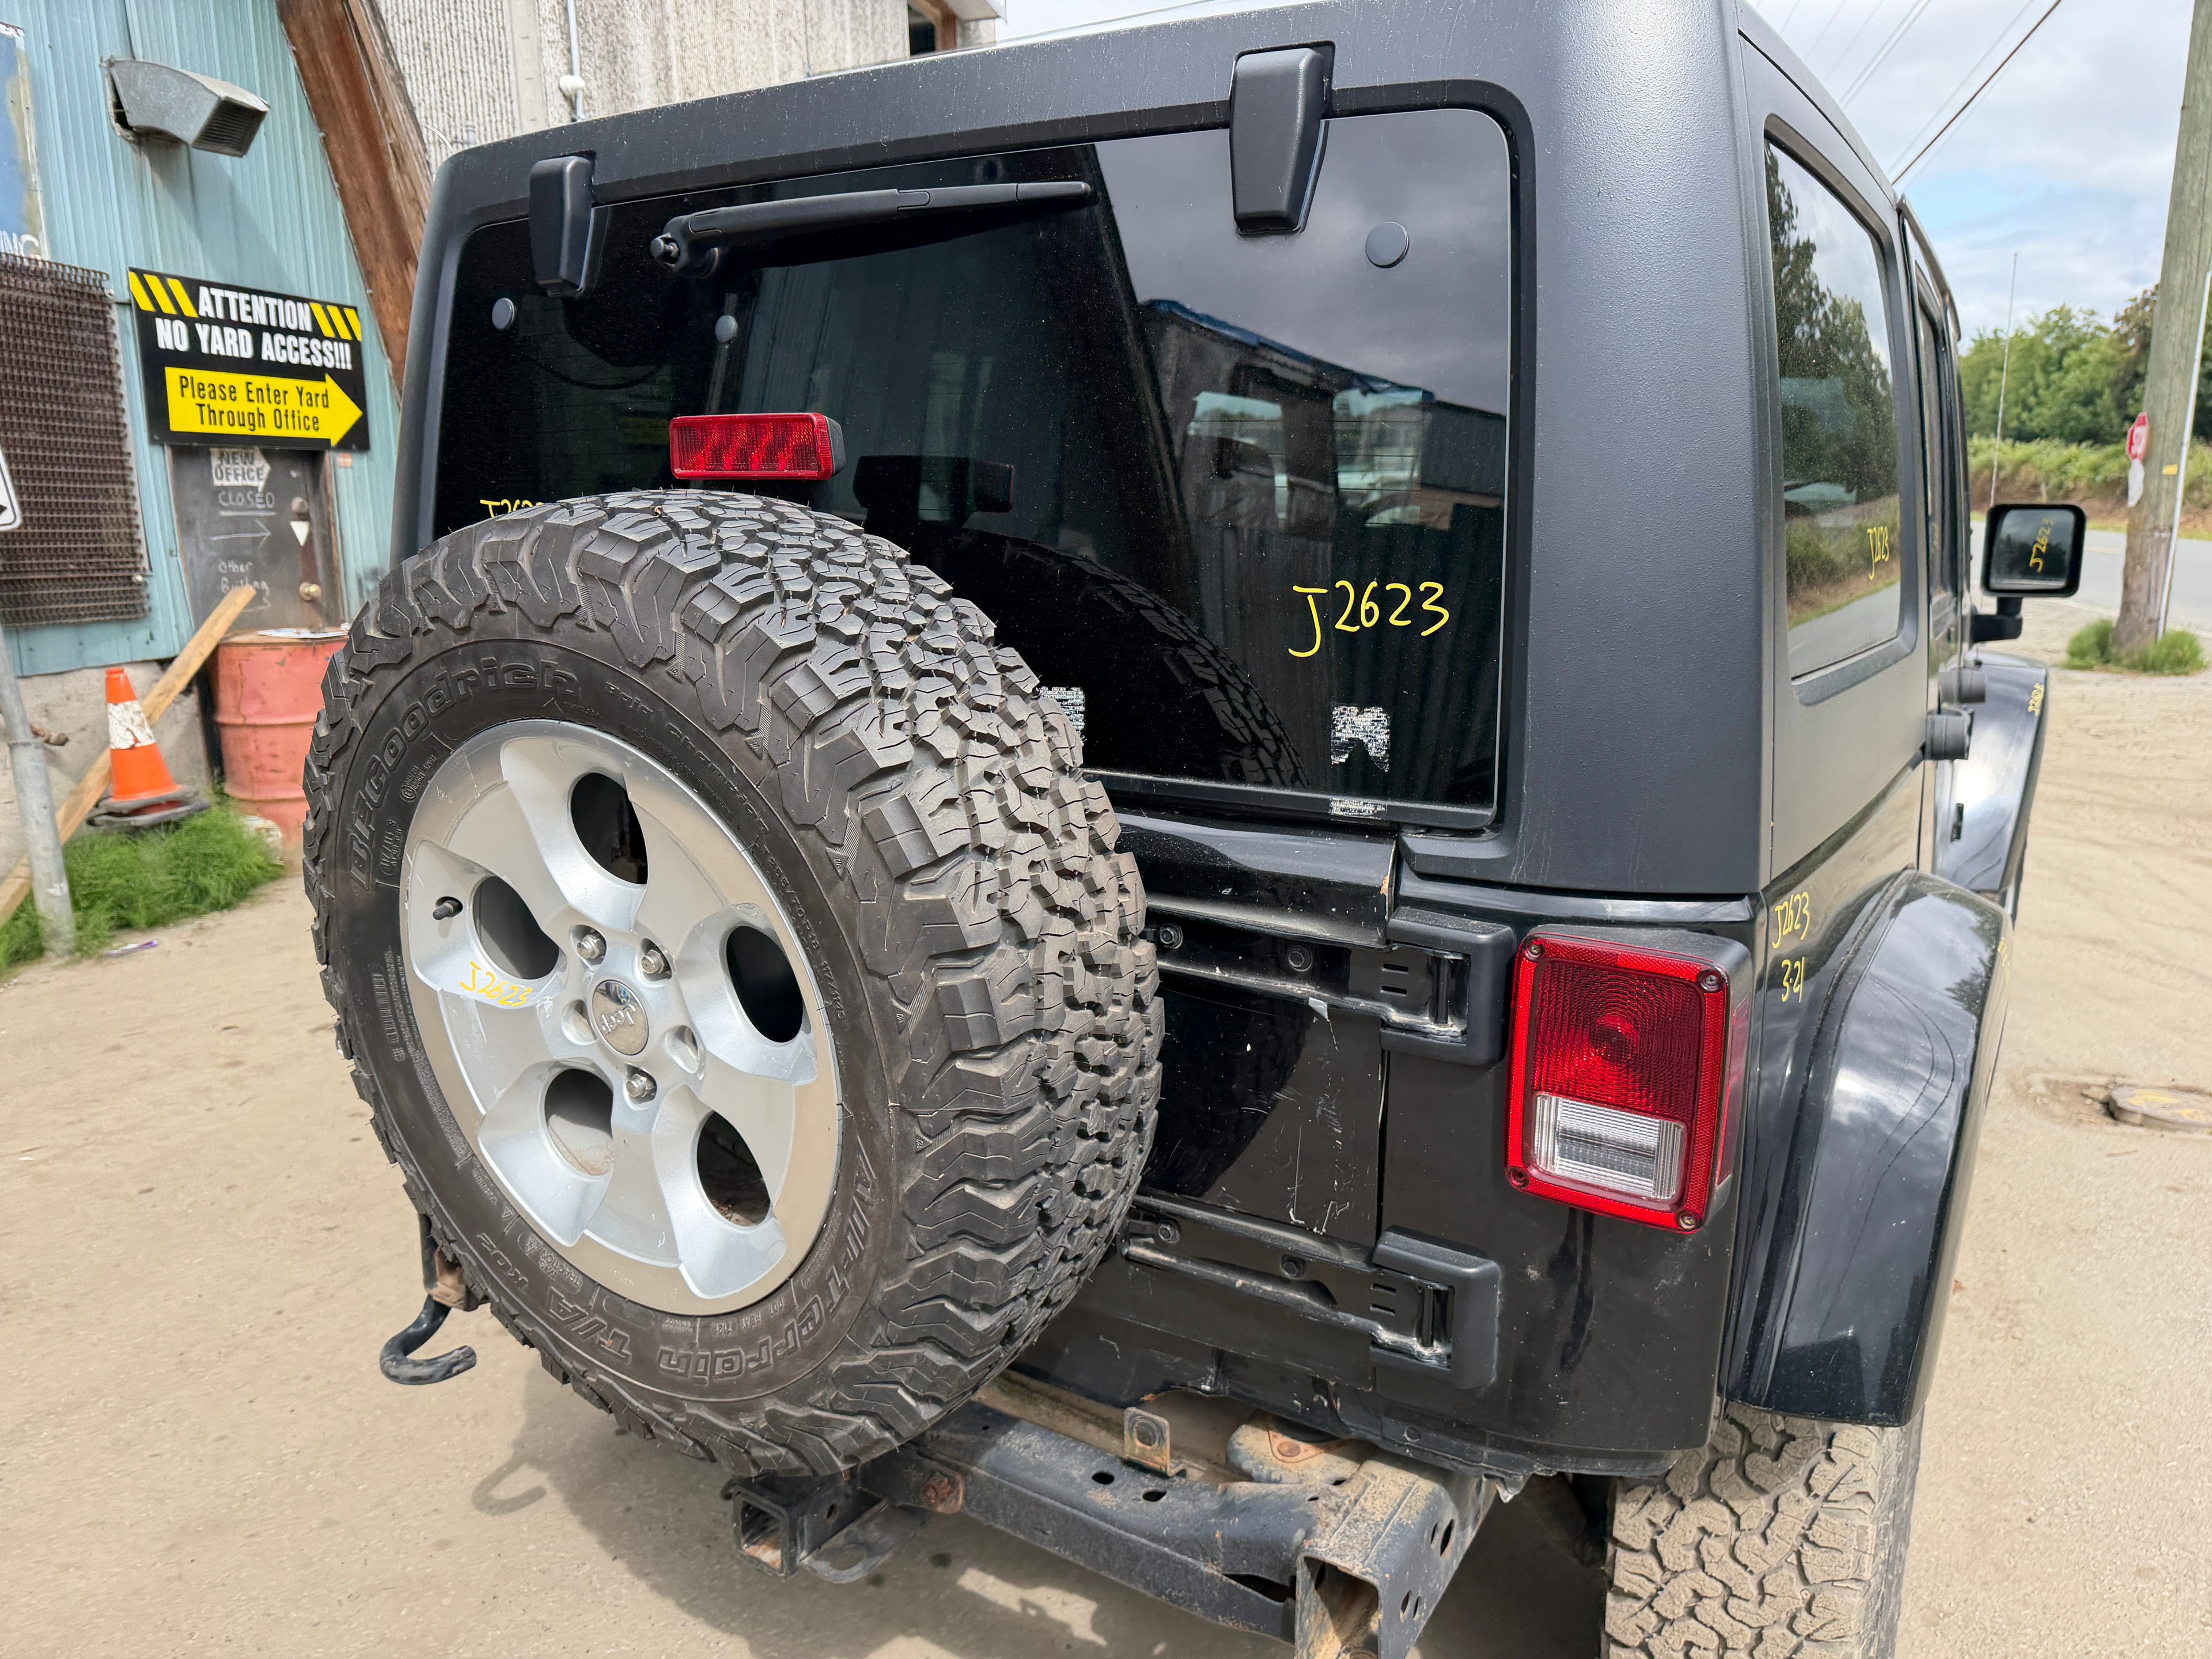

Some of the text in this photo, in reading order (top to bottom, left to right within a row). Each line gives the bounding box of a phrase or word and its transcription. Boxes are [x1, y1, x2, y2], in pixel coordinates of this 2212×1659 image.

[198, 286, 313, 332] ATTENTION
[155, 317, 353, 370] NO YARD ACCESS!!!
[179, 376, 329, 408] Please Enter Yard
[196, 403, 320, 432] Through Office
[214, 465, 264, 482] OFFICE
[220, 450, 257, 467] NEW
[218, 491, 275, 509] CLOSED
[1289, 580, 1450, 657] J2623
[1771, 891, 1810, 949] J2623
[460, 961, 533, 1007] J2623
[601, 1003, 636, 1035] Jeep
